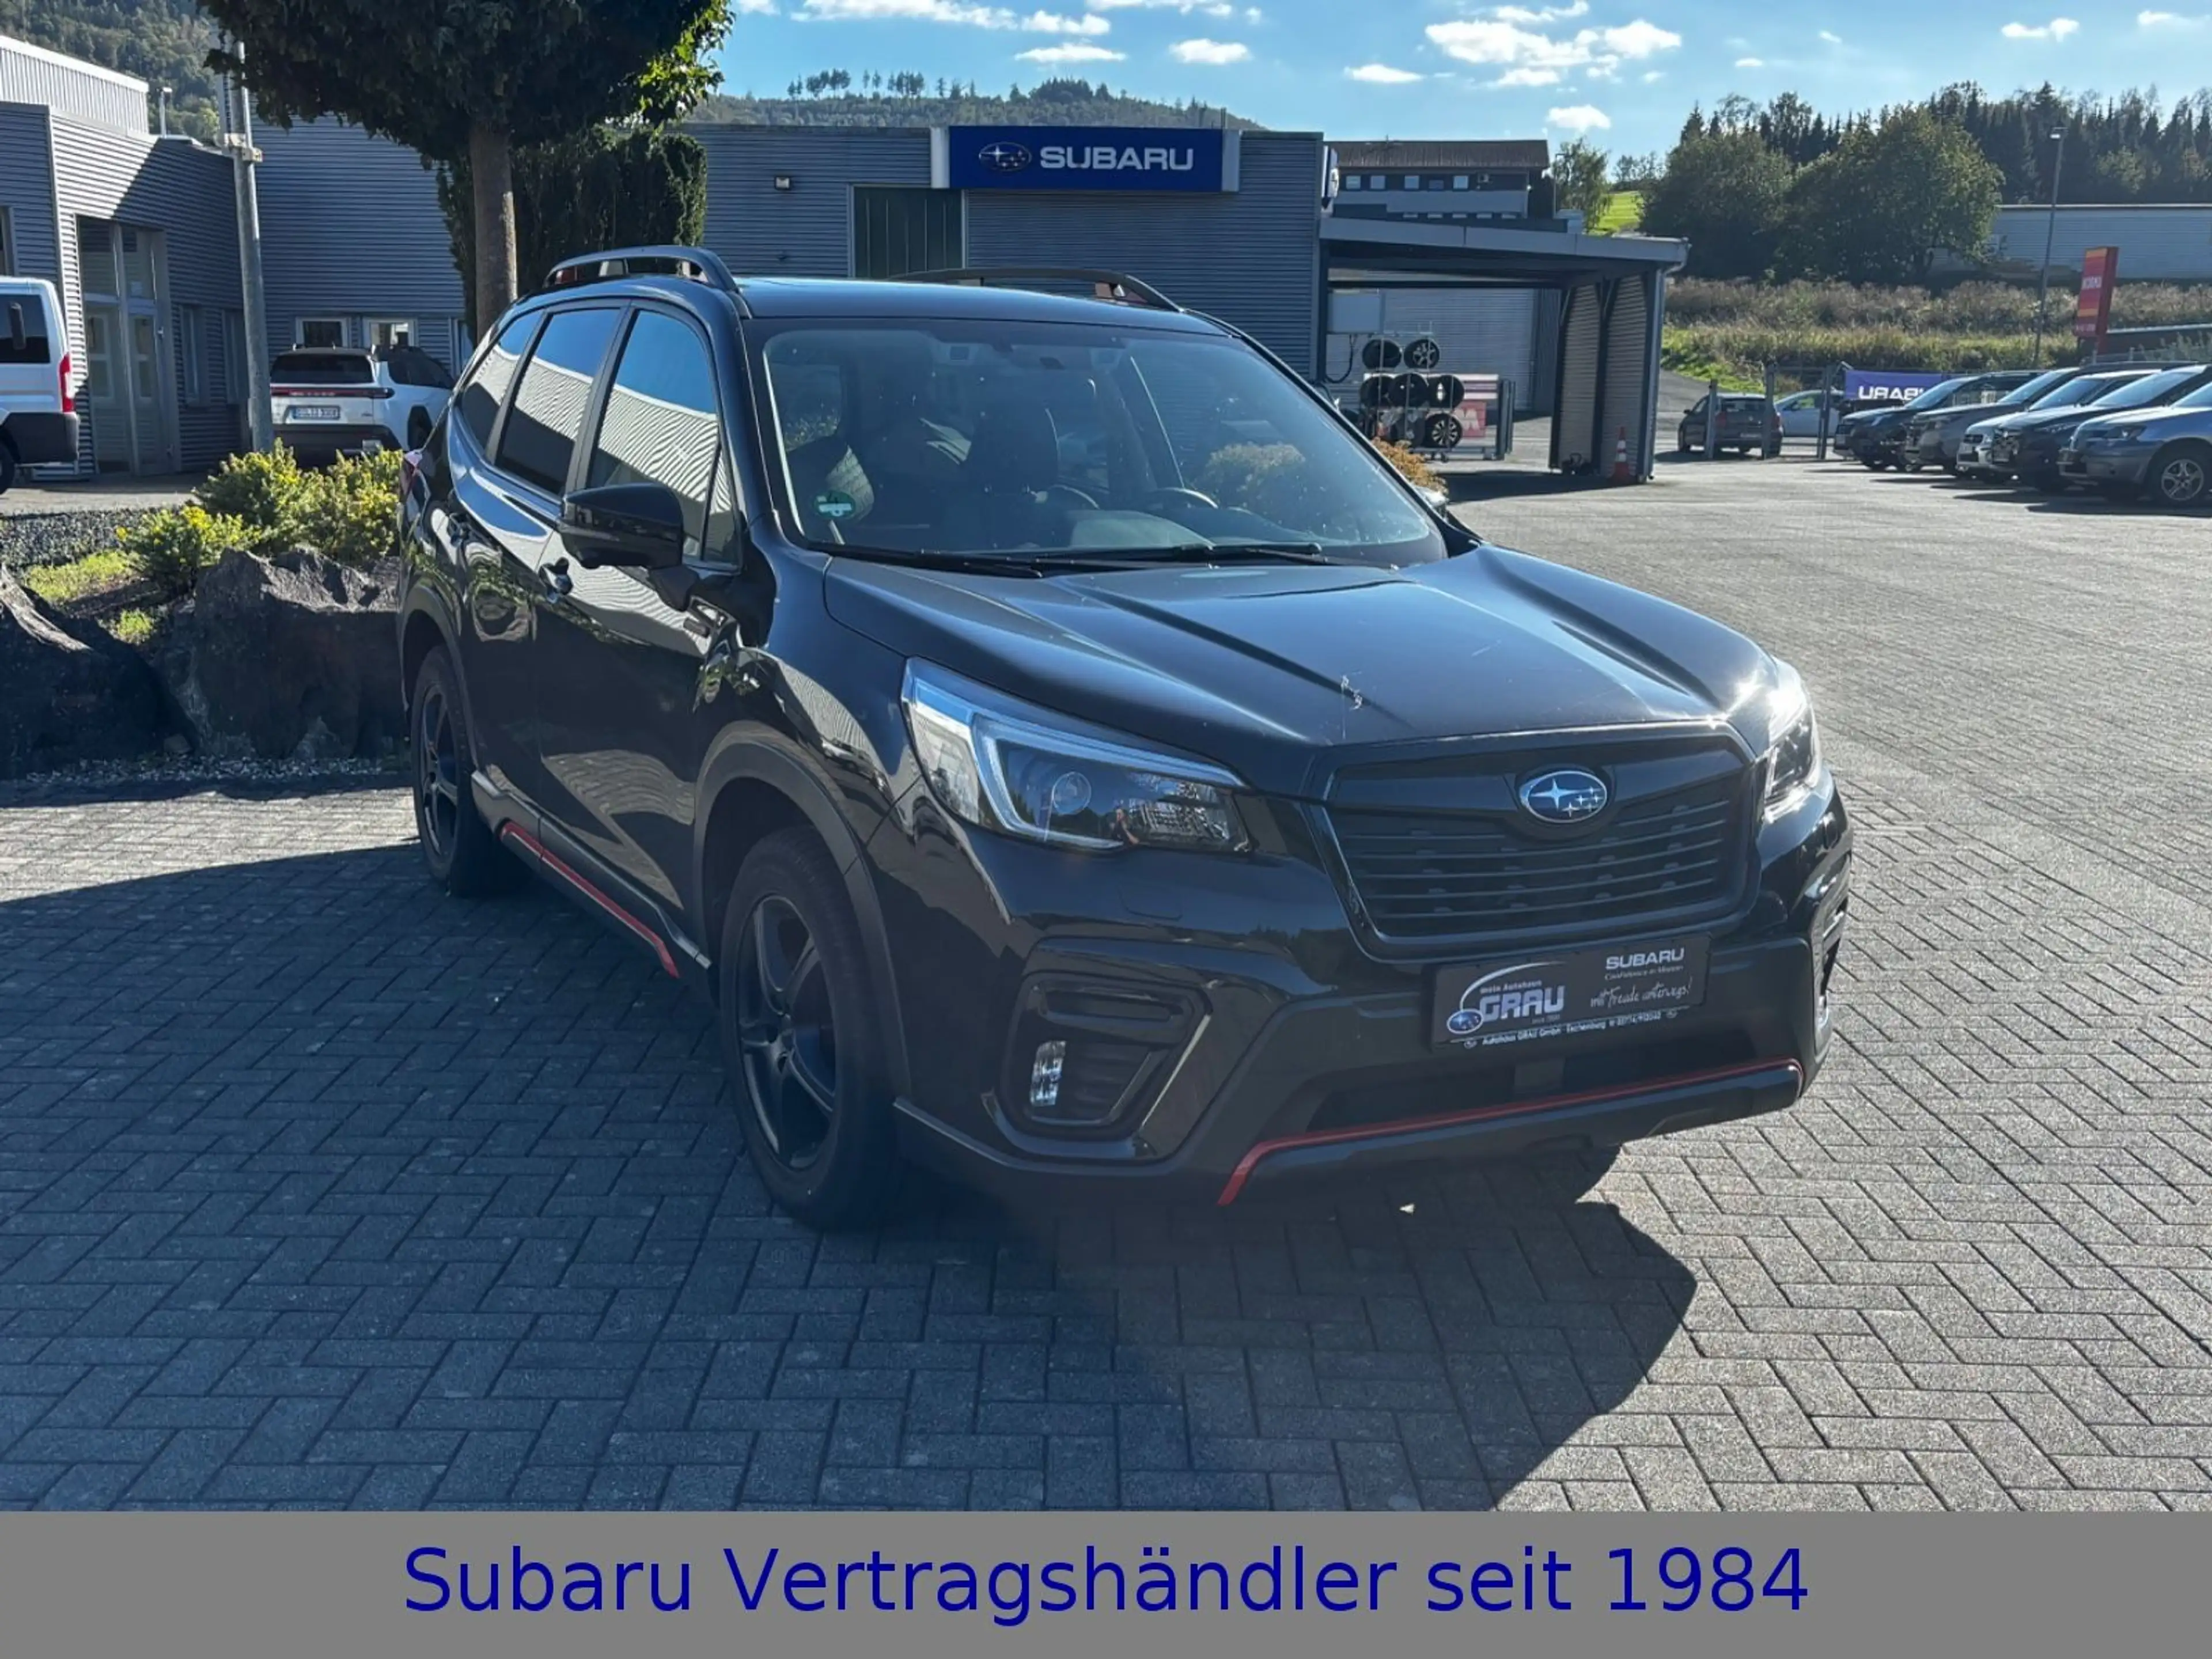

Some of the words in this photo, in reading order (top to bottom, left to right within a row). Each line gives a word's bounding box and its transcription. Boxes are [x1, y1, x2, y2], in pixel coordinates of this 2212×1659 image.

[1040, 146, 1194, 171] SUBARU
[1605, 948, 1685, 970] SUBARU
[1503, 980, 1542, 991] Autohaus
[1479, 986, 1566, 1022] GRAU
